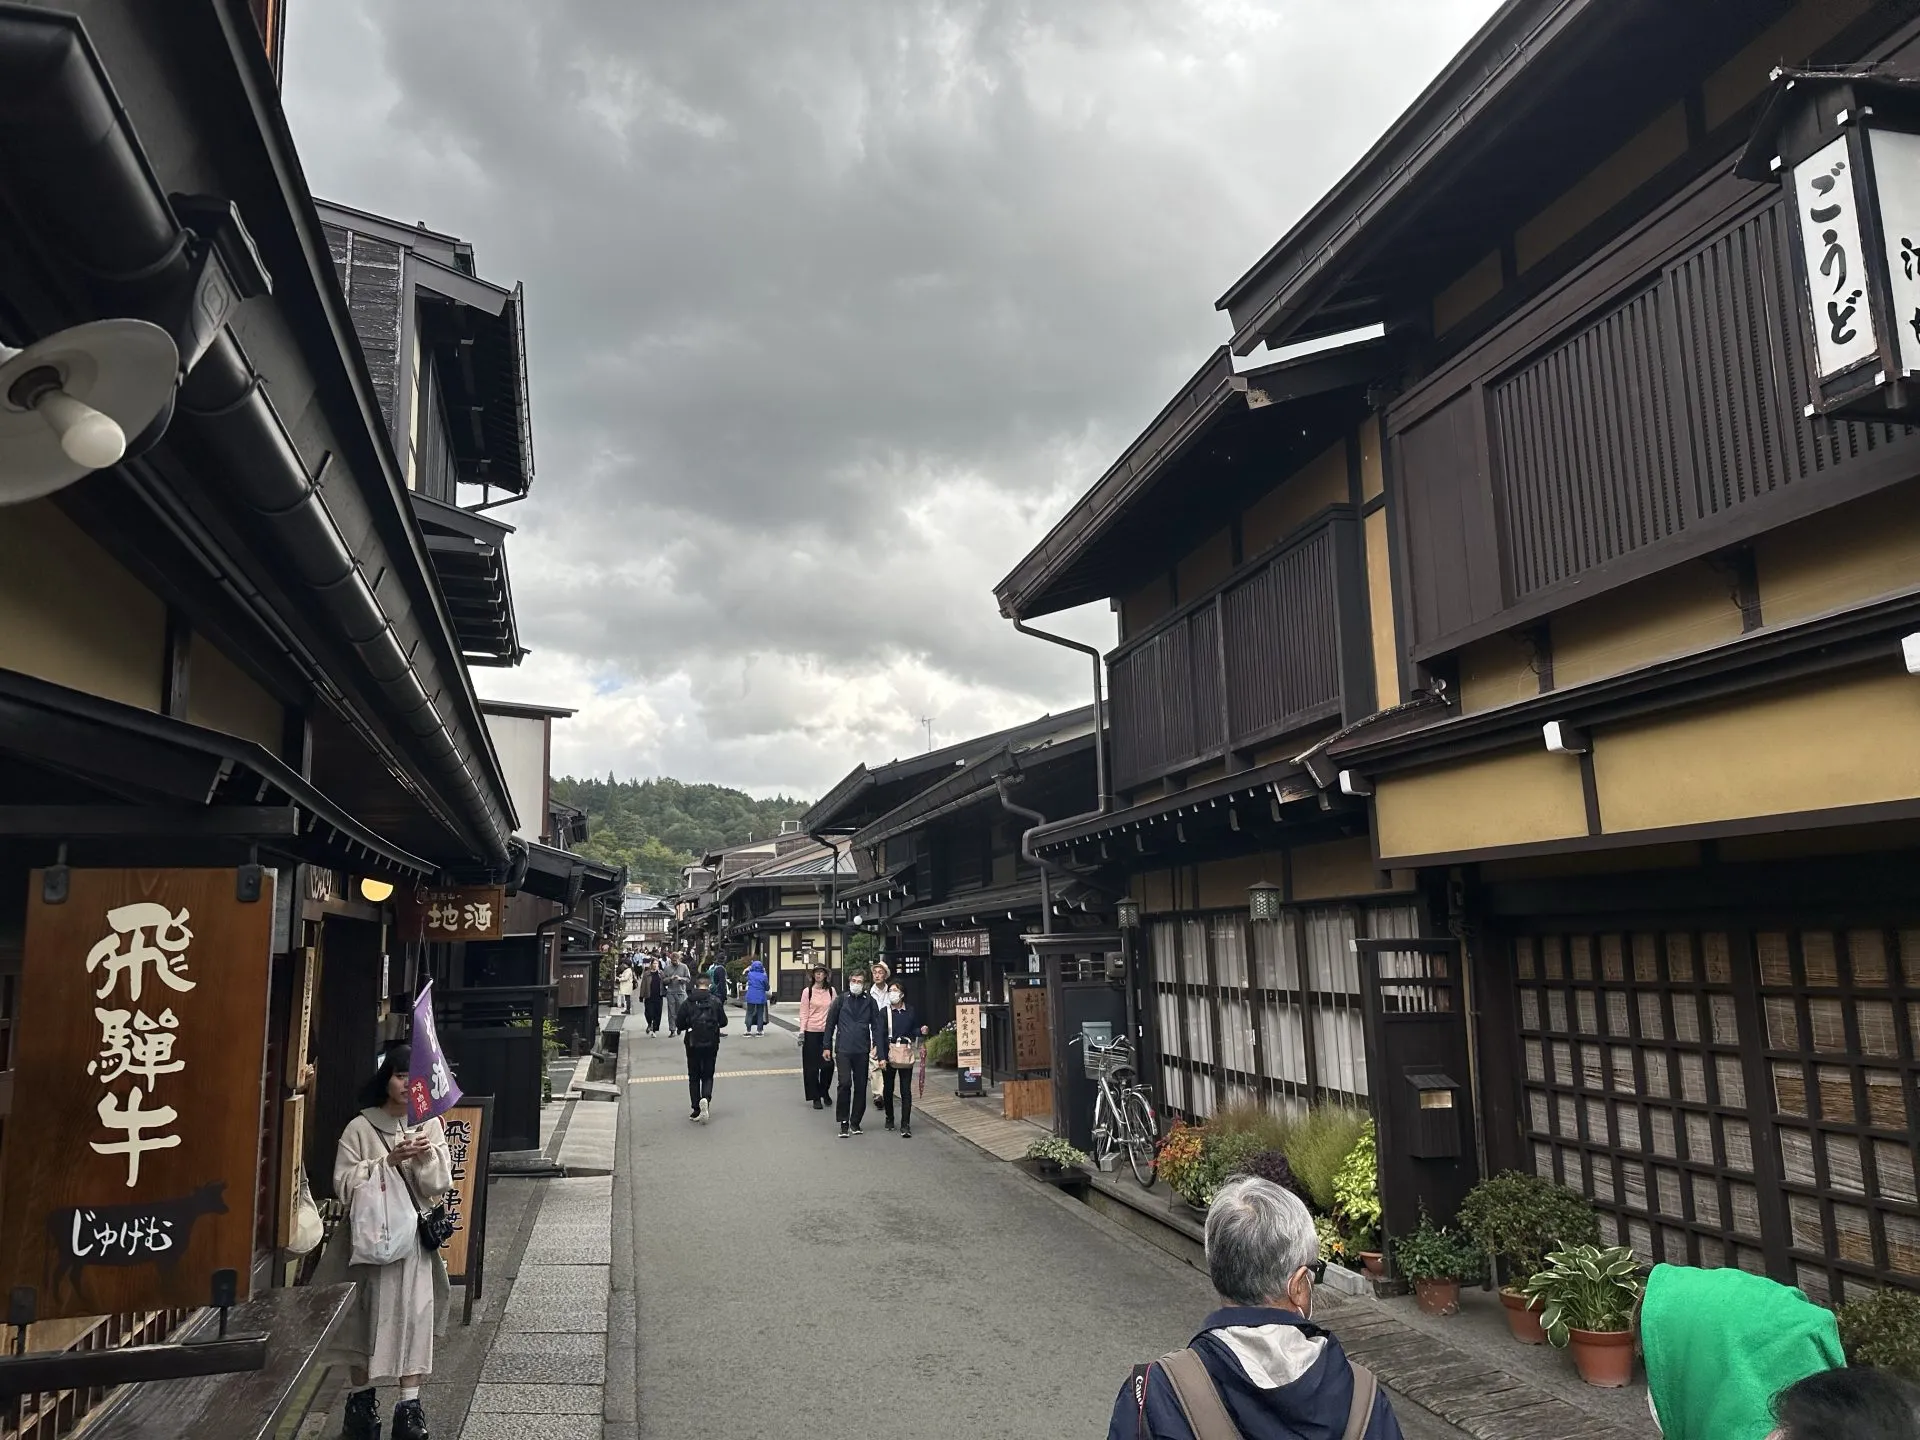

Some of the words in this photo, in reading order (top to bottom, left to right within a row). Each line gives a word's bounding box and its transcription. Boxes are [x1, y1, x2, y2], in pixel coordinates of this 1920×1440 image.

[1810, 161, 1863, 345] ごうど
[427, 902, 492, 932] 地酒
[71, 1208, 174, 1257] じゅげむ
